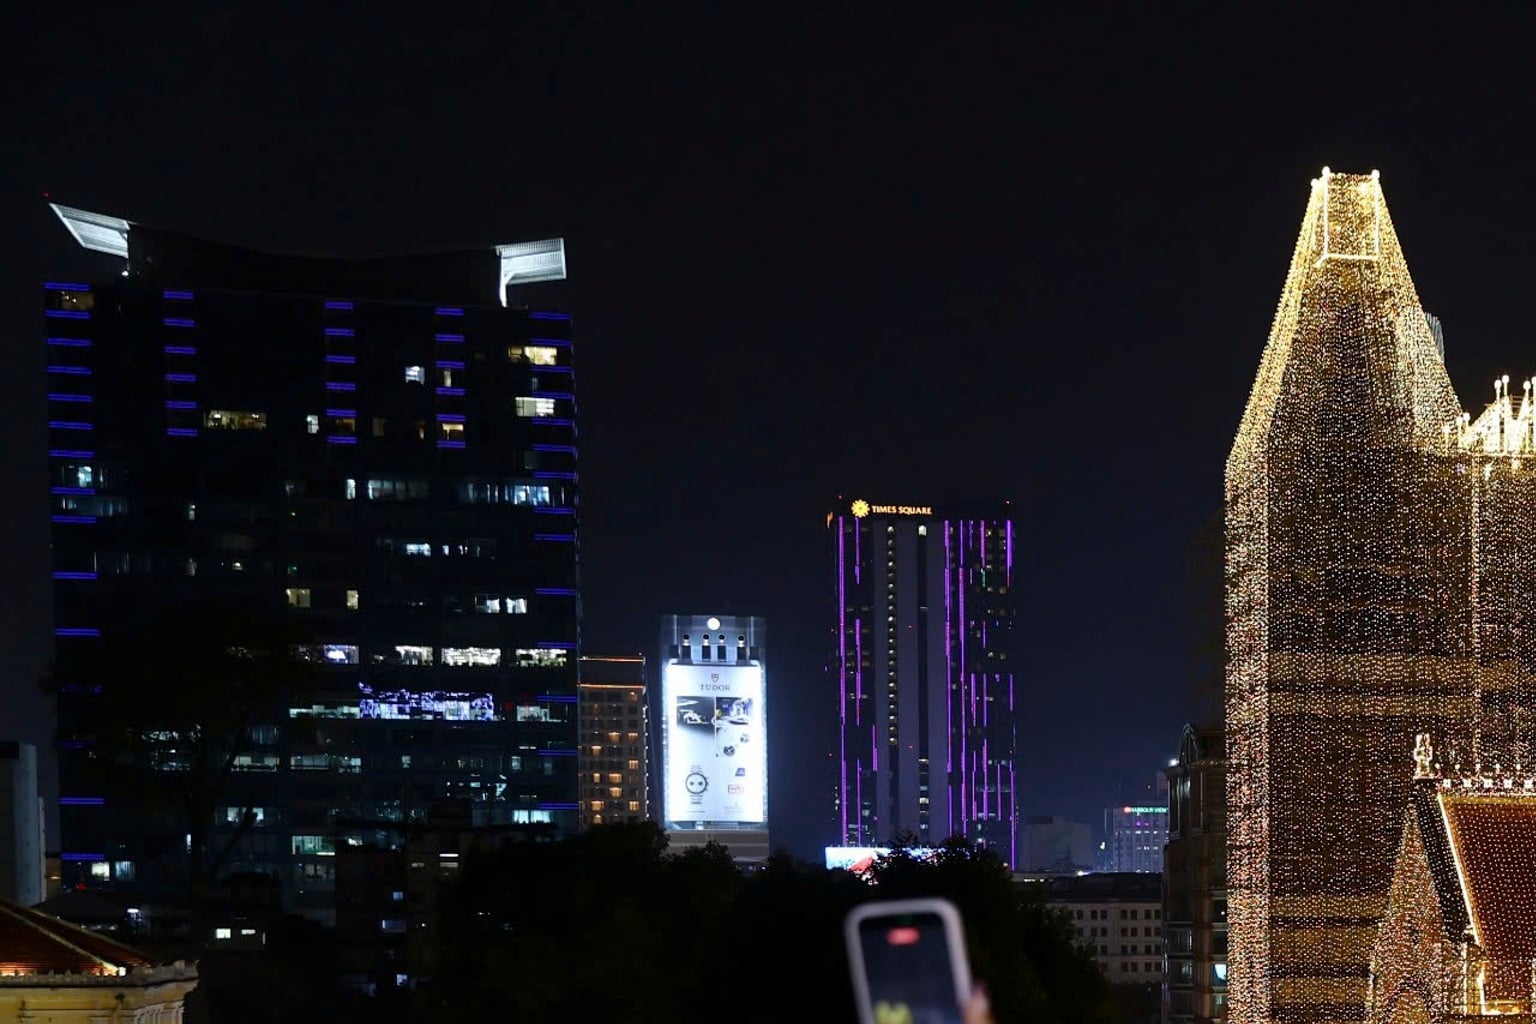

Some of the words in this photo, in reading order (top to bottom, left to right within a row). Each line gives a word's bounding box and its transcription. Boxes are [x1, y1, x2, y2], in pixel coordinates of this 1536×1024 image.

[871, 505, 897, 514] TIMES
[898, 505, 932, 515] SQUARE
[700, 684, 730, 692] TUDOR
